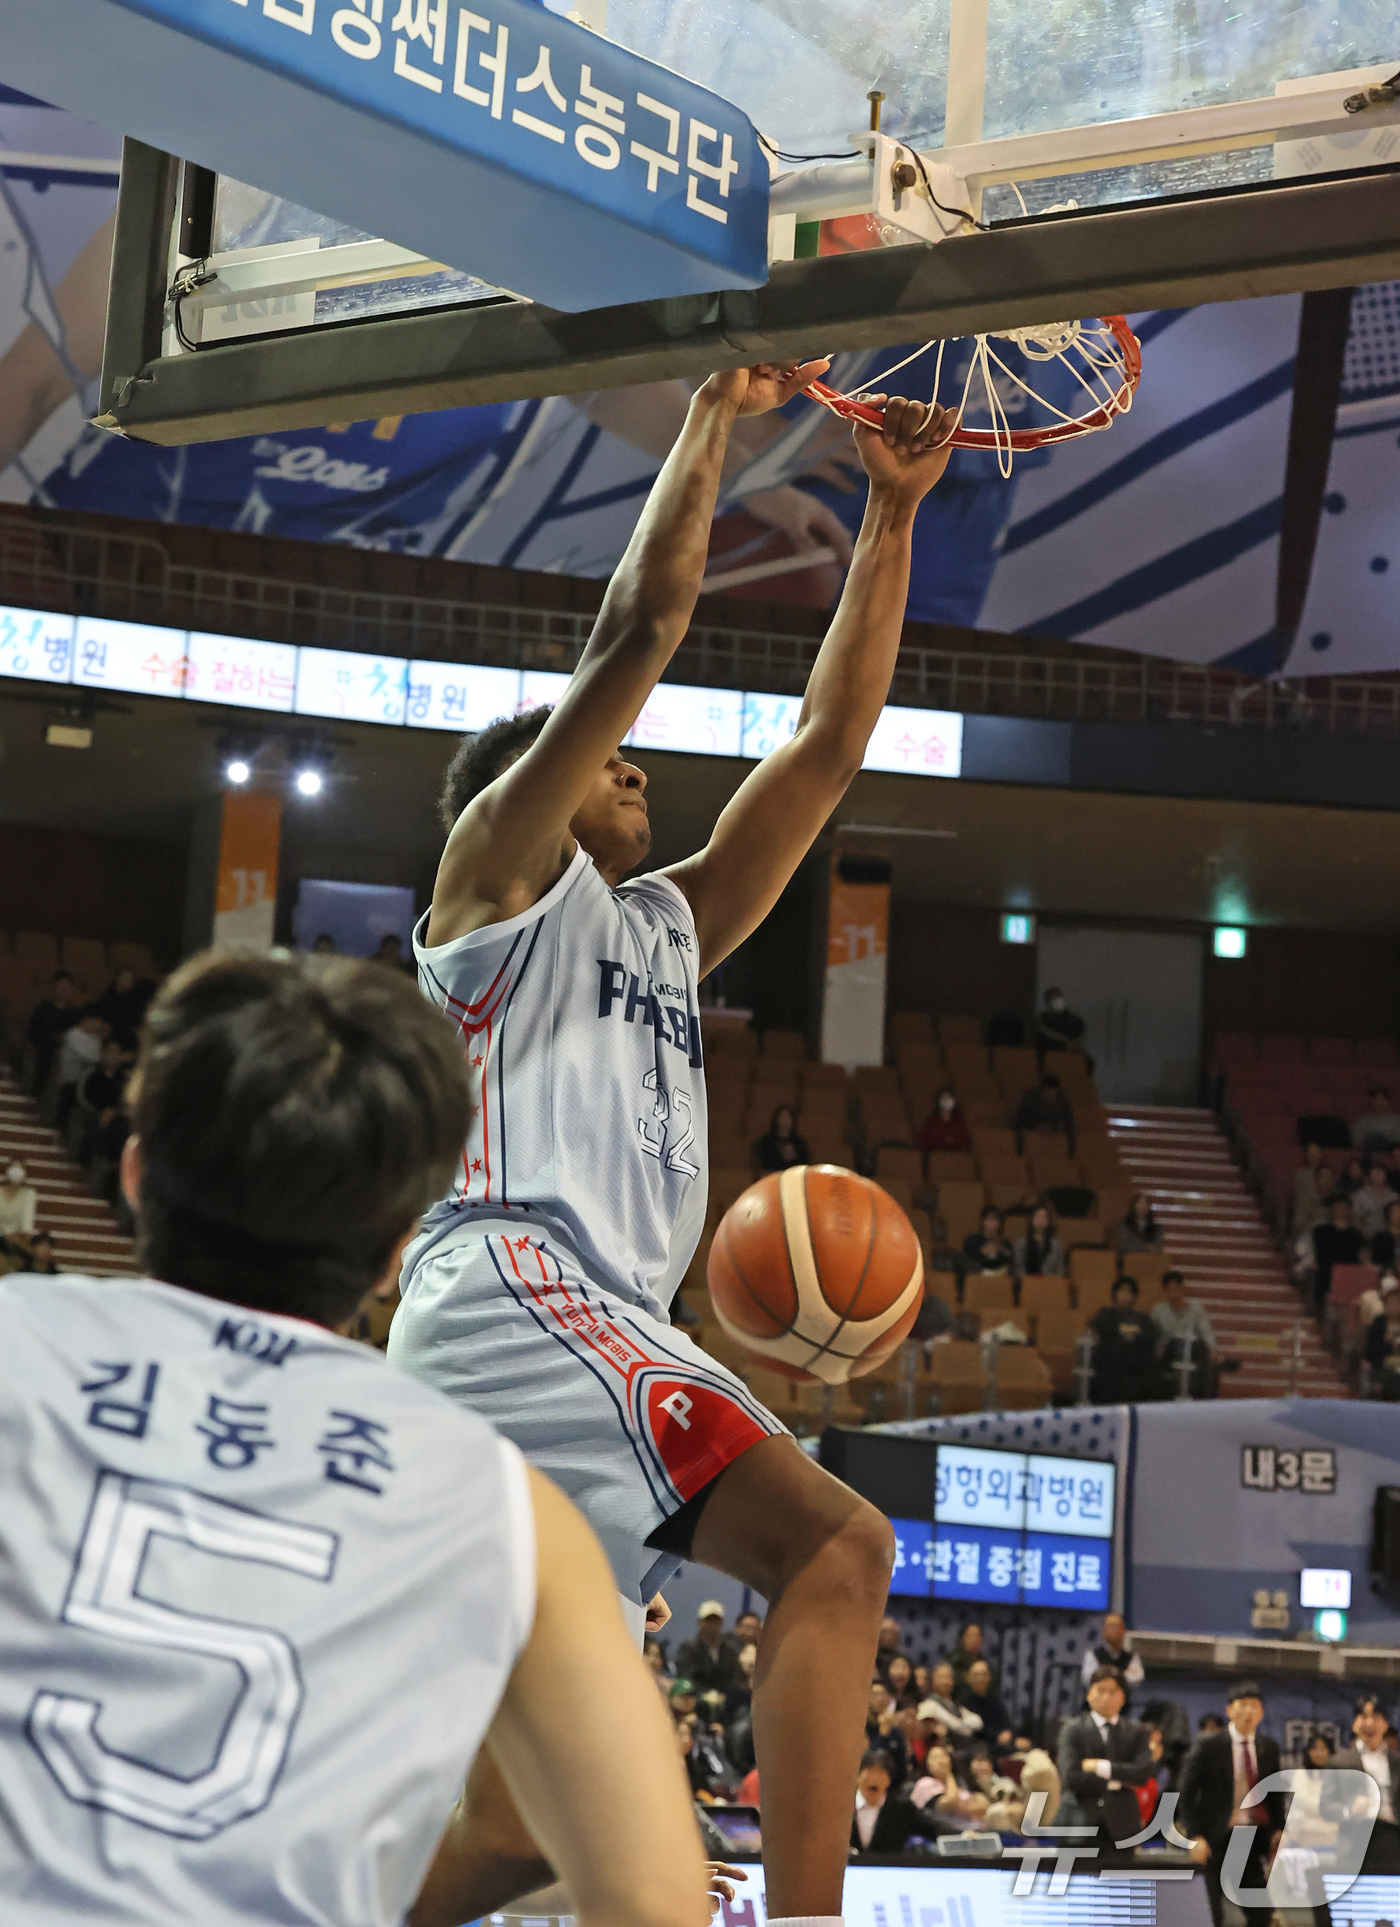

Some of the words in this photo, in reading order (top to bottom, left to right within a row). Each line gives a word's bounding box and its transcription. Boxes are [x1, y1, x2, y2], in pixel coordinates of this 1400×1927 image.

[212, 660, 296, 700] 잘하는
[893, 733, 948, 766] 수술
[596, 1331, 632, 1362] MOBIS
[81, 1361, 395, 1496] 김동준
[657, 1390, 693, 1431] P
[1244, 1448, 1335, 1491] 내3문
[1050, 1551, 1102, 1593] 진료
[25, 1469, 341, 1842] 5
